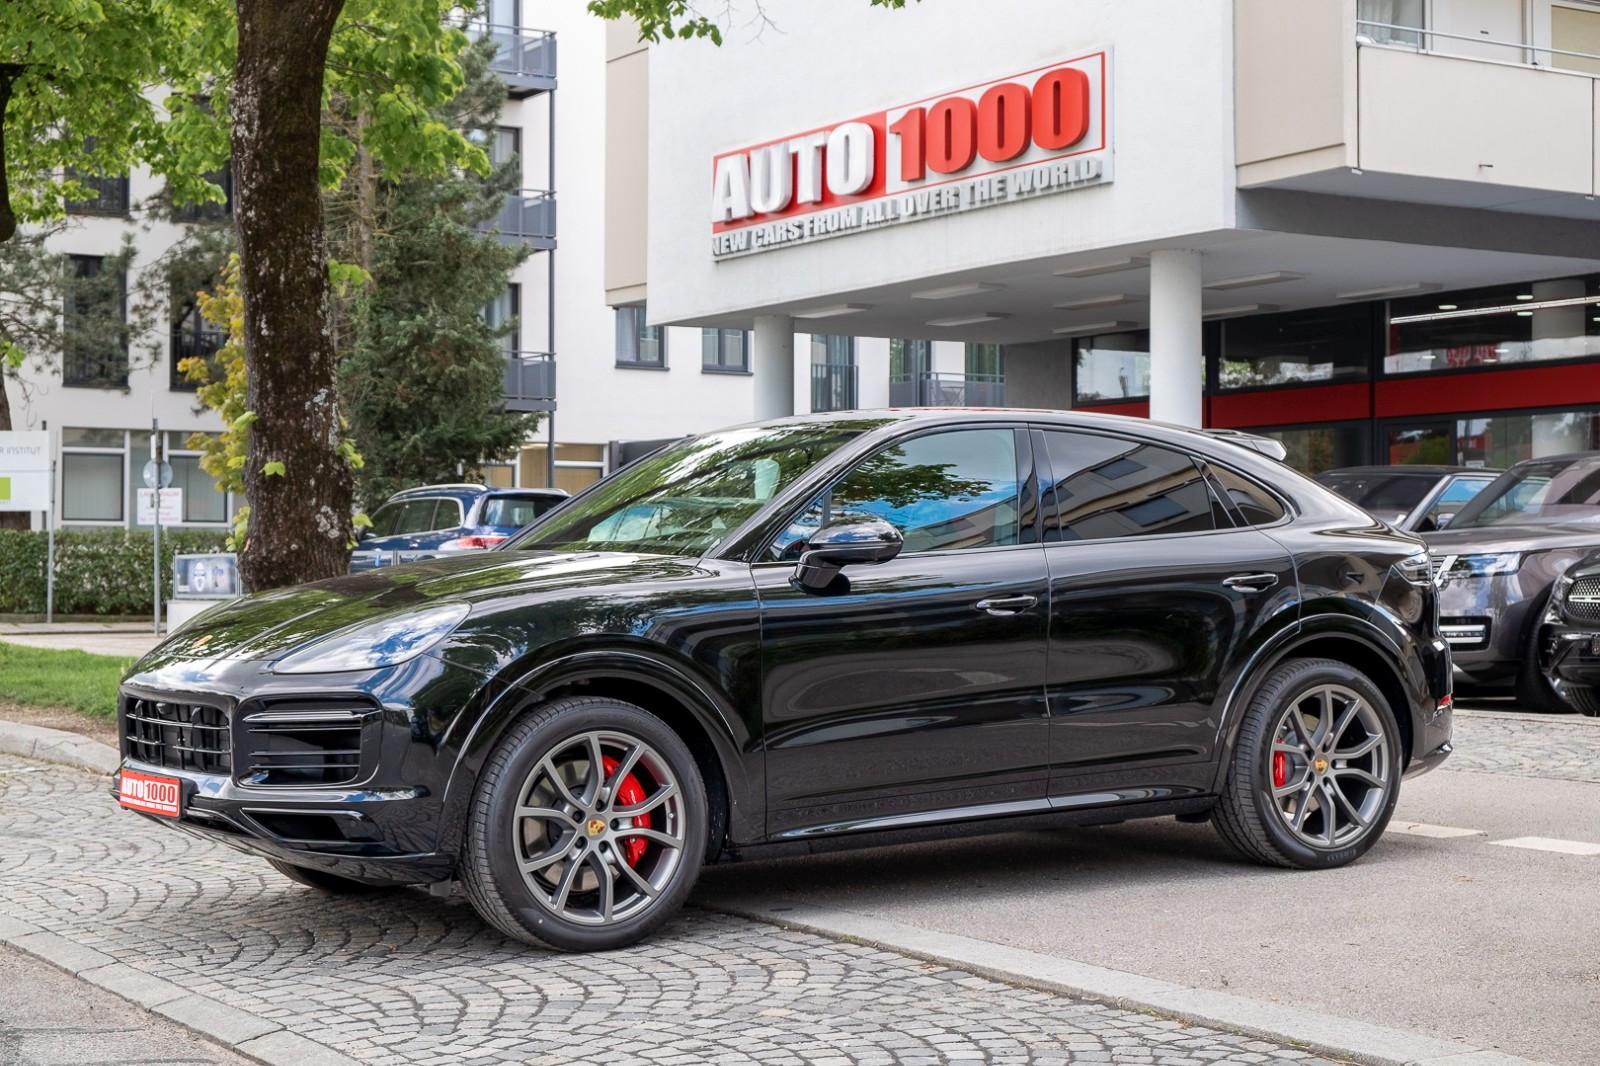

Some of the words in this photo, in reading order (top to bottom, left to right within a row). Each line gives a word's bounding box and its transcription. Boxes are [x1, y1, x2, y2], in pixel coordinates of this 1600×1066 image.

[712, 122, 875, 222] AUTO
[889, 67, 1090, 182] 1000
[712, 229, 750, 256] NEW
[751, 221, 802, 248] CARS
[803, 206, 862, 236] FROM
[862, 198, 901, 226] ALL
[903, 186, 960, 216] OVER
[964, 177, 1010, 206] THE
[6, 446, 41, 455] INSTITUT
[121, 777, 144, 798] AUTO
[146, 783, 175, 803] 1000
